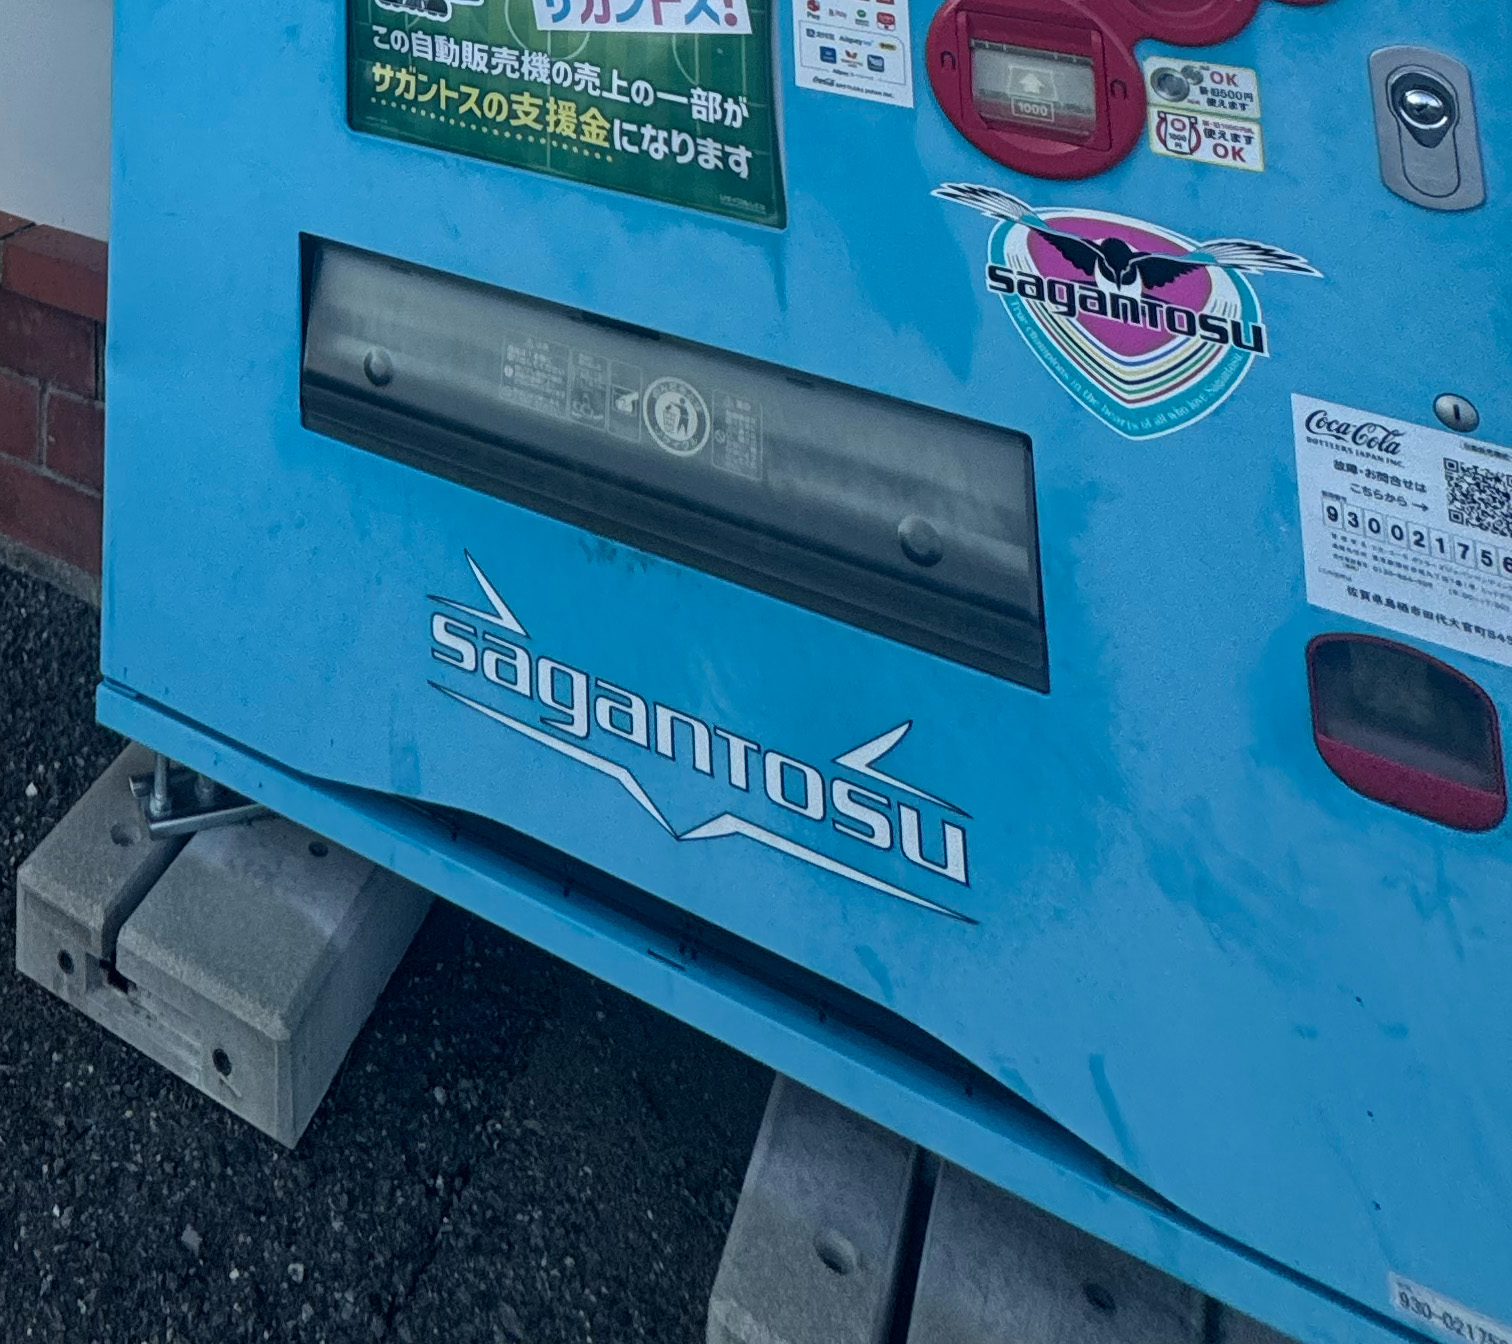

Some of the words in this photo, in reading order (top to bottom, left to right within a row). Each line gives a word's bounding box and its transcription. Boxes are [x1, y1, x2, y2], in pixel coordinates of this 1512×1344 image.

[371, 23, 750, 130] この自動販売機の売上の一部が
[1210, 70, 1239, 88] OK
[1015, 101, 1049, 117] 1000
[1206, 98, 1250, 112] 使えます
[371, 62, 754, 181] サガントスの支援金になります
[1203, 128, 1255, 145] 使えます
[1212, 143, 1246, 163] OK
[1304, 408, 1404, 456] Coca-Cola
[1349, 482, 1409, 508] こちらから
